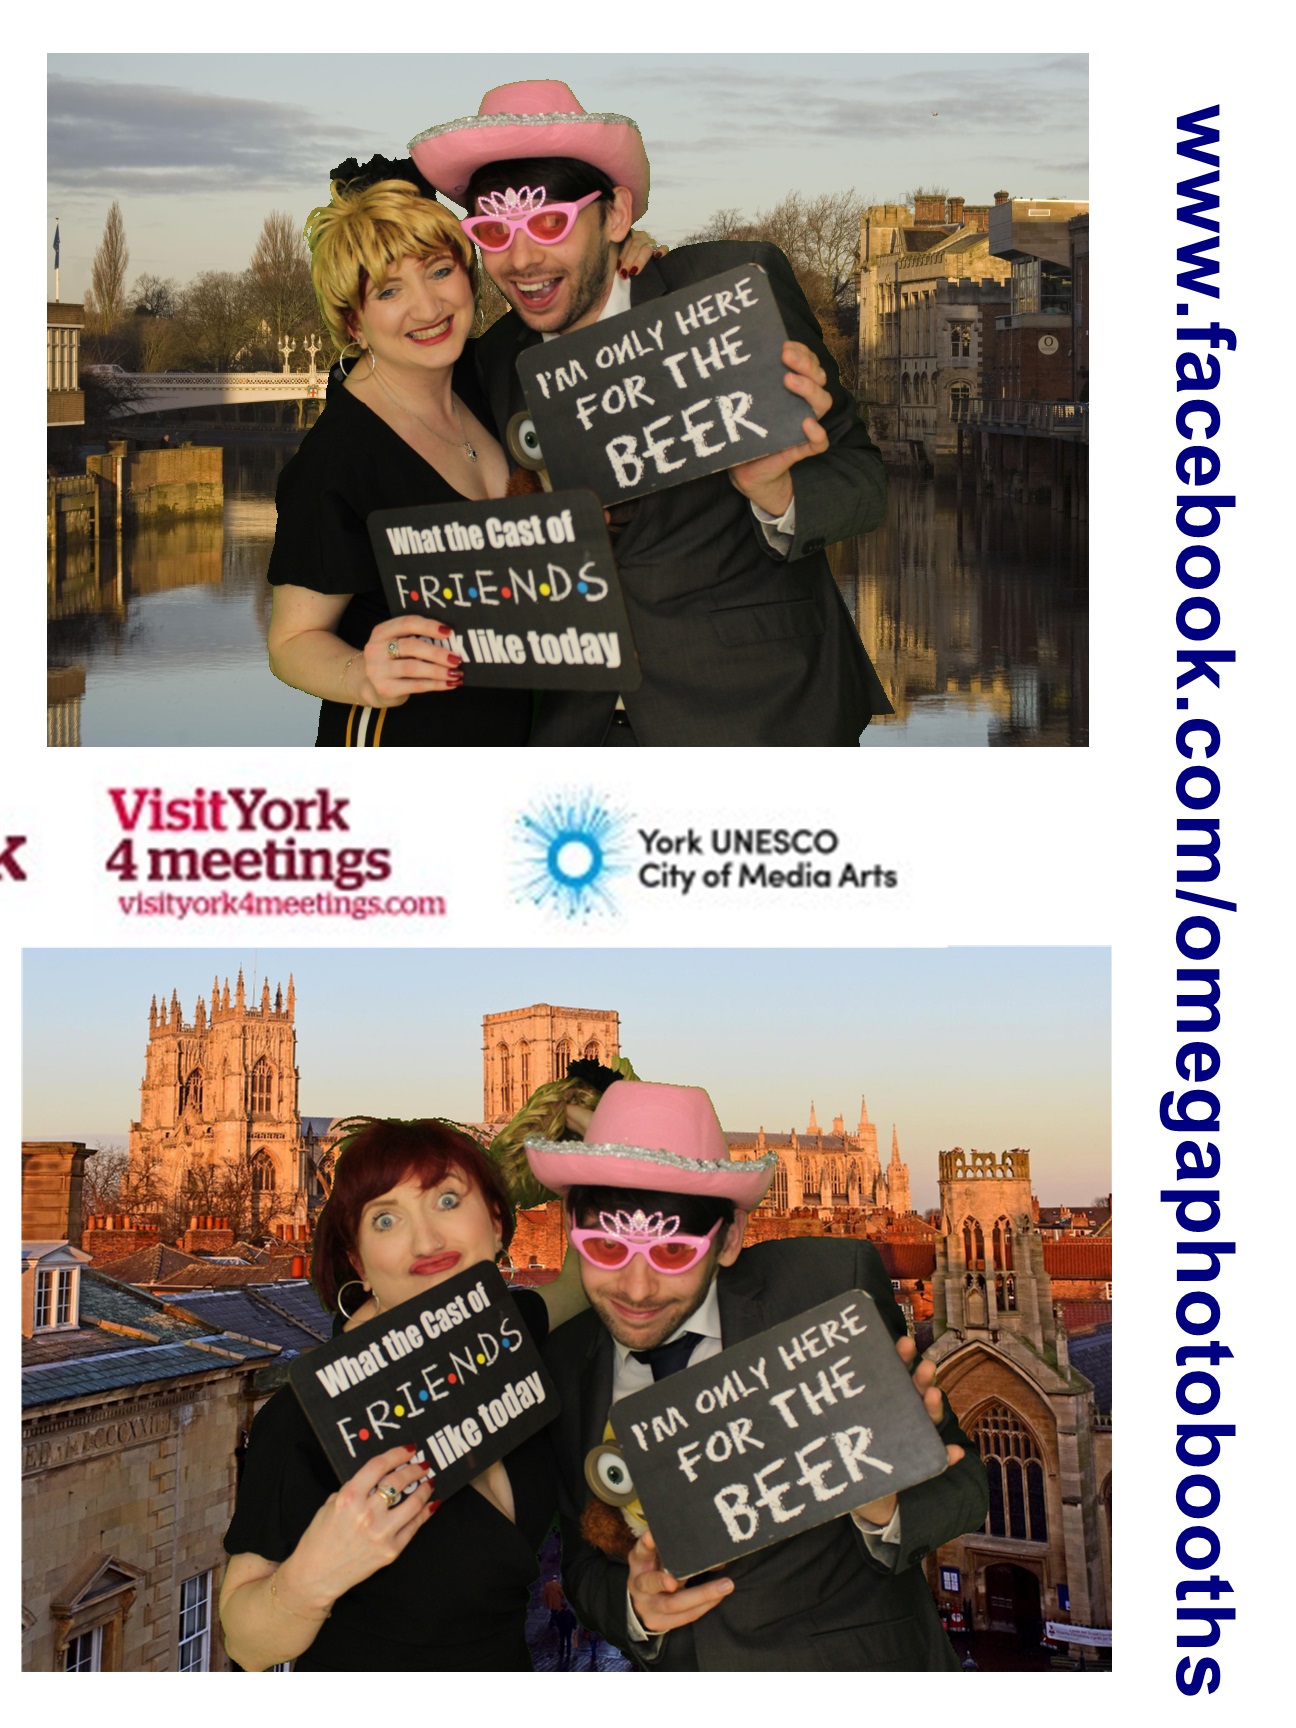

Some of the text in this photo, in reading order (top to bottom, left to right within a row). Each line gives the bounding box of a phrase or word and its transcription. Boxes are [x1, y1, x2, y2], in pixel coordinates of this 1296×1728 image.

[536, 277, 758, 399] I'M ONLY HERE
[576, 326, 751, 430] FOR THE
[604, 391, 768, 488] BEER
[387, 509, 575, 555] What the Cast of
[467, 628, 526, 664] like
[527, 627, 621, 669] today
[316, 1282, 491, 1399] What the Cast of
[630, 1304, 867, 1451] I'M ONLY HERE
[427, 1416, 483, 1481] like
[477, 1371, 546, 1439] today
[677, 1357, 866, 1482] FOR THE
[713, 1425, 893, 1544] BEER
